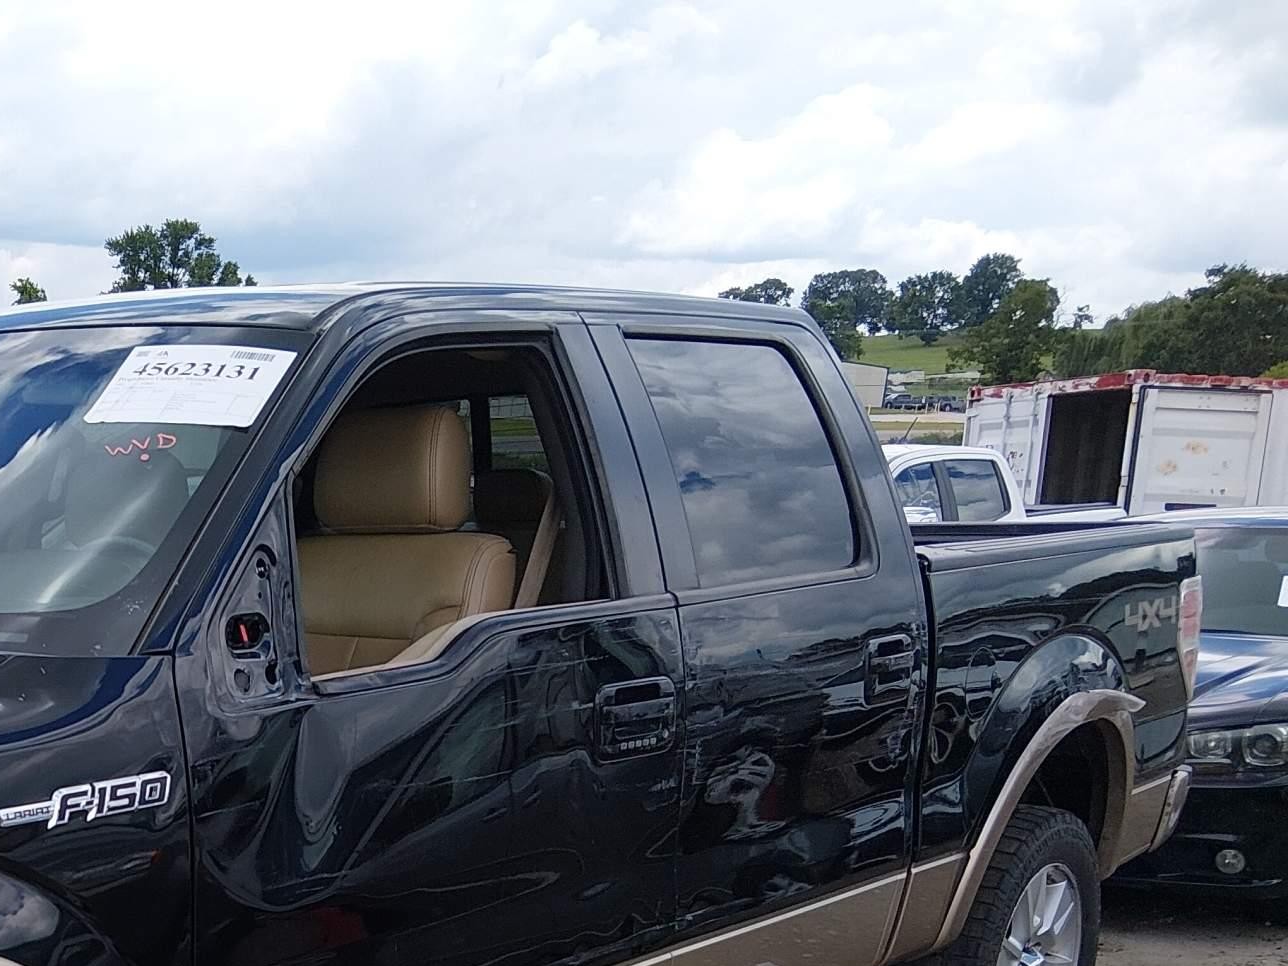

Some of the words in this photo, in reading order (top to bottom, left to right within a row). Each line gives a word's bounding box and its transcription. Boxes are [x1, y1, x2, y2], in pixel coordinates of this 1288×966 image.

[132, 361, 261, 381] 45623131
[6, 805, 53, 821] LARIAT
[50, 770, 171, 829] F-150
